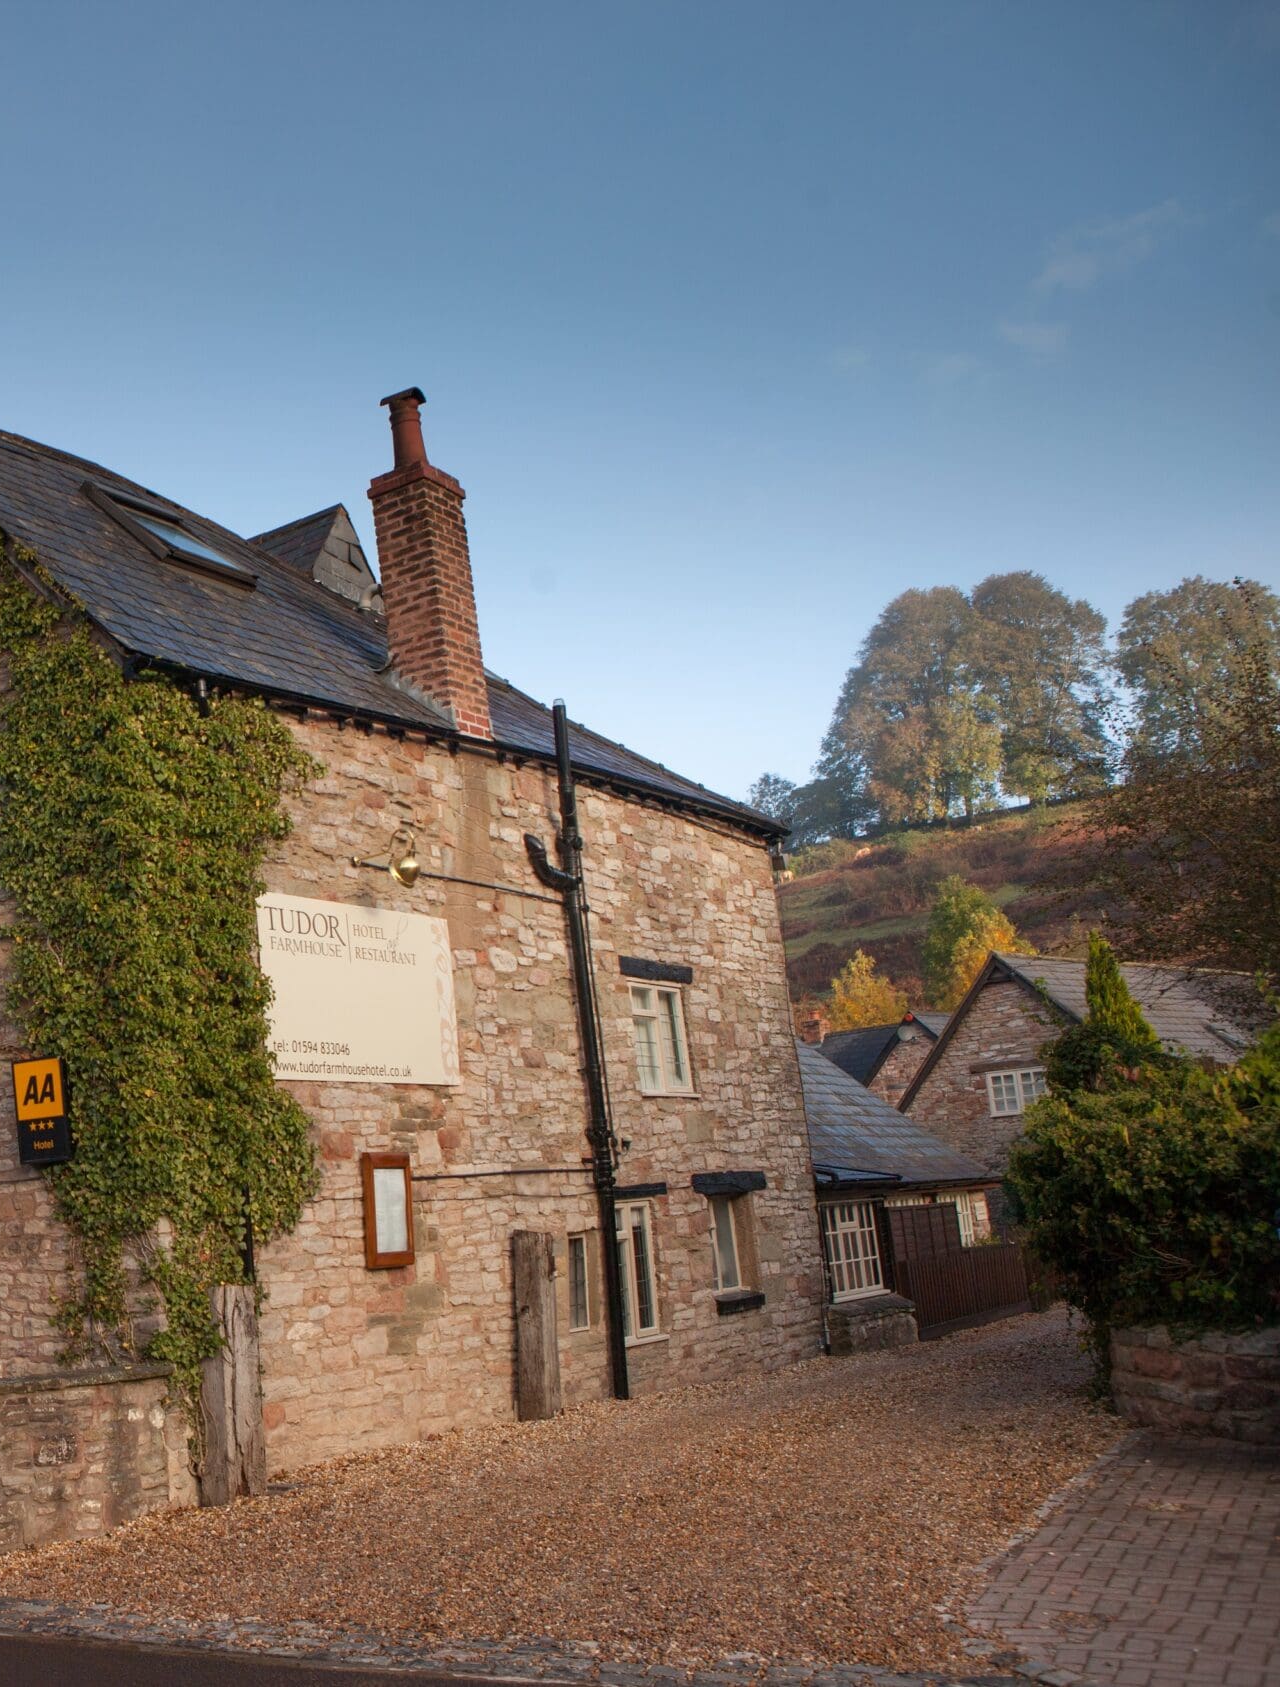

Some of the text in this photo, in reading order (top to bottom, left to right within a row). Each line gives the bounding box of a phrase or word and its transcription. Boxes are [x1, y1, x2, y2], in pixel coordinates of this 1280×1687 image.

[264, 906, 347, 946] TUDOR
[353, 924, 387, 940] HOTEL
[270, 936, 343, 958] FARMHOUSE
[354, 946, 417, 966] RESTAURANT
[273, 1040, 351, 1056] tel: 01594 833046
[23, 1073, 55, 1106] AA
[33, 1140, 54, 1150] Hotel
